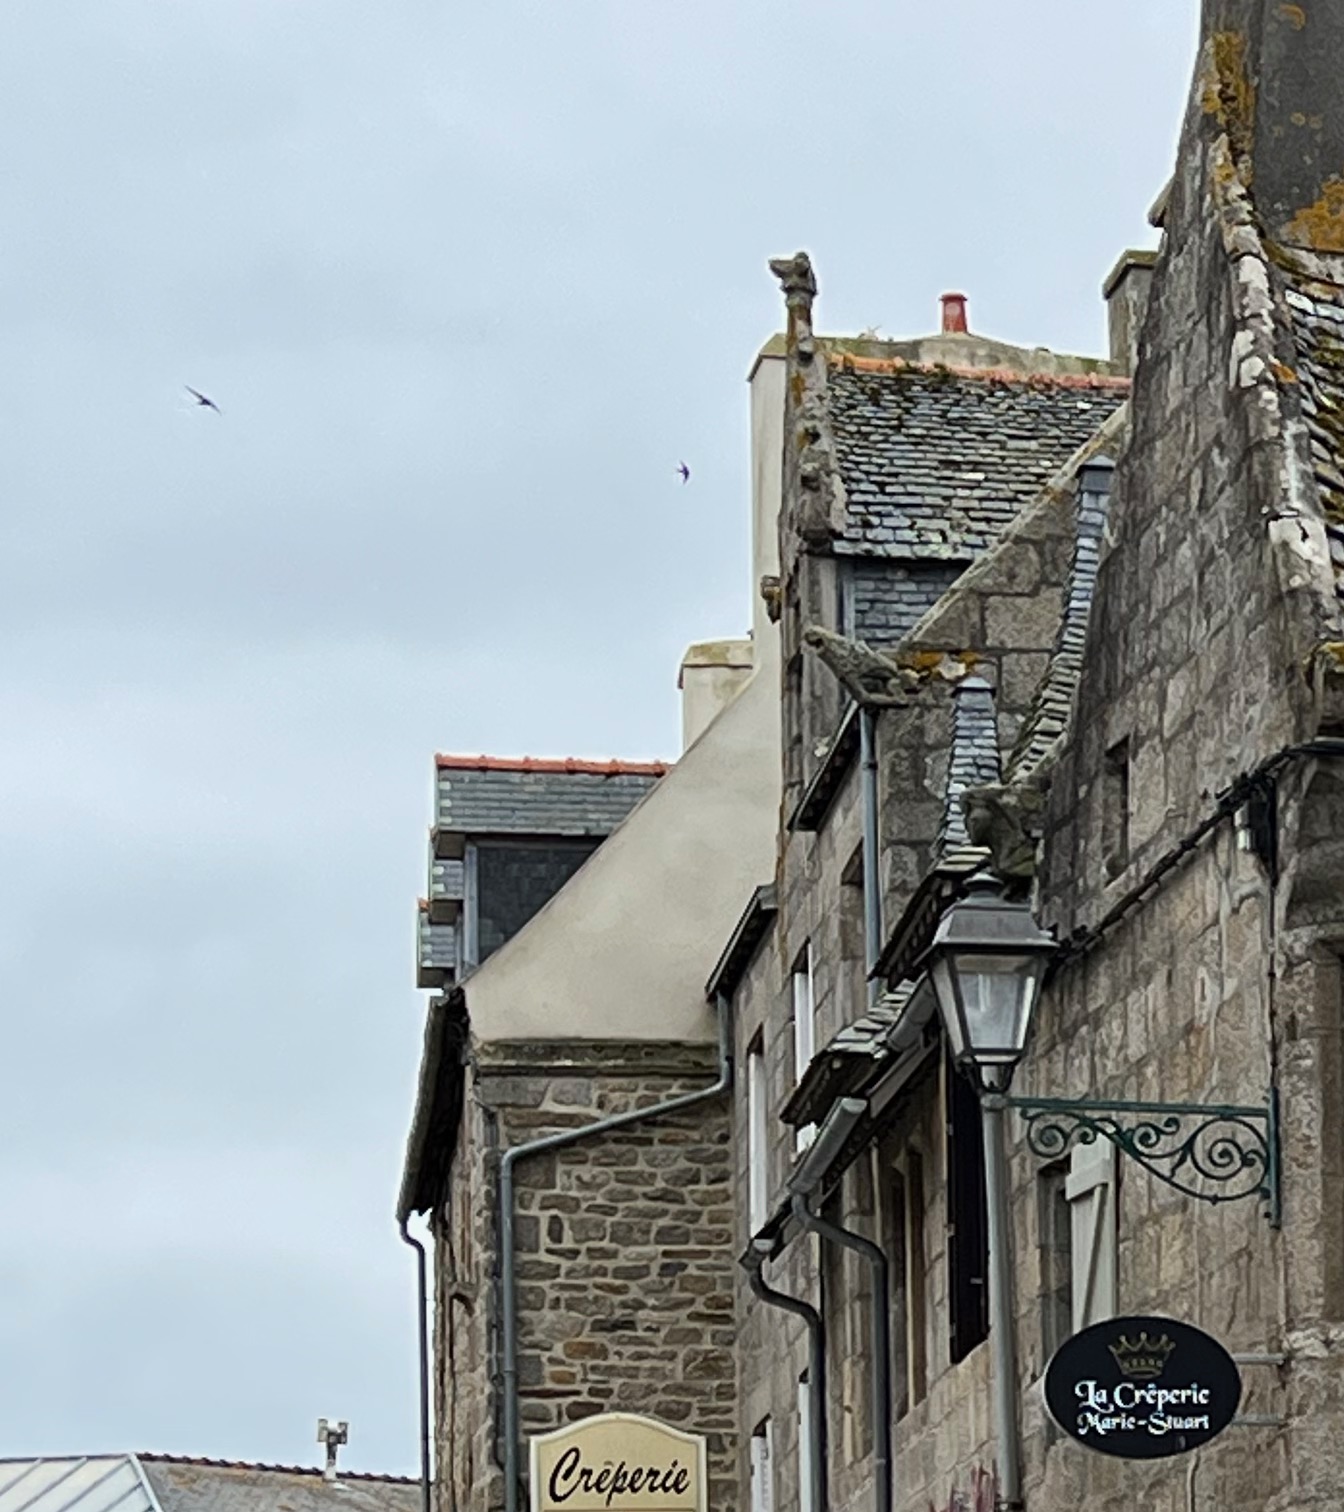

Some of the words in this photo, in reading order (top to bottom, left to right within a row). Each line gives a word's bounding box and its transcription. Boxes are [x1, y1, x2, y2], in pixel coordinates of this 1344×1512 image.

[1074, 1380, 1114, 1413] La
[1113, 1382, 1210, 1413] Crêperie
[1076, 1411, 1209, 1435] Marie-Stuart
[549, 1447, 690, 1507] Crêperie
